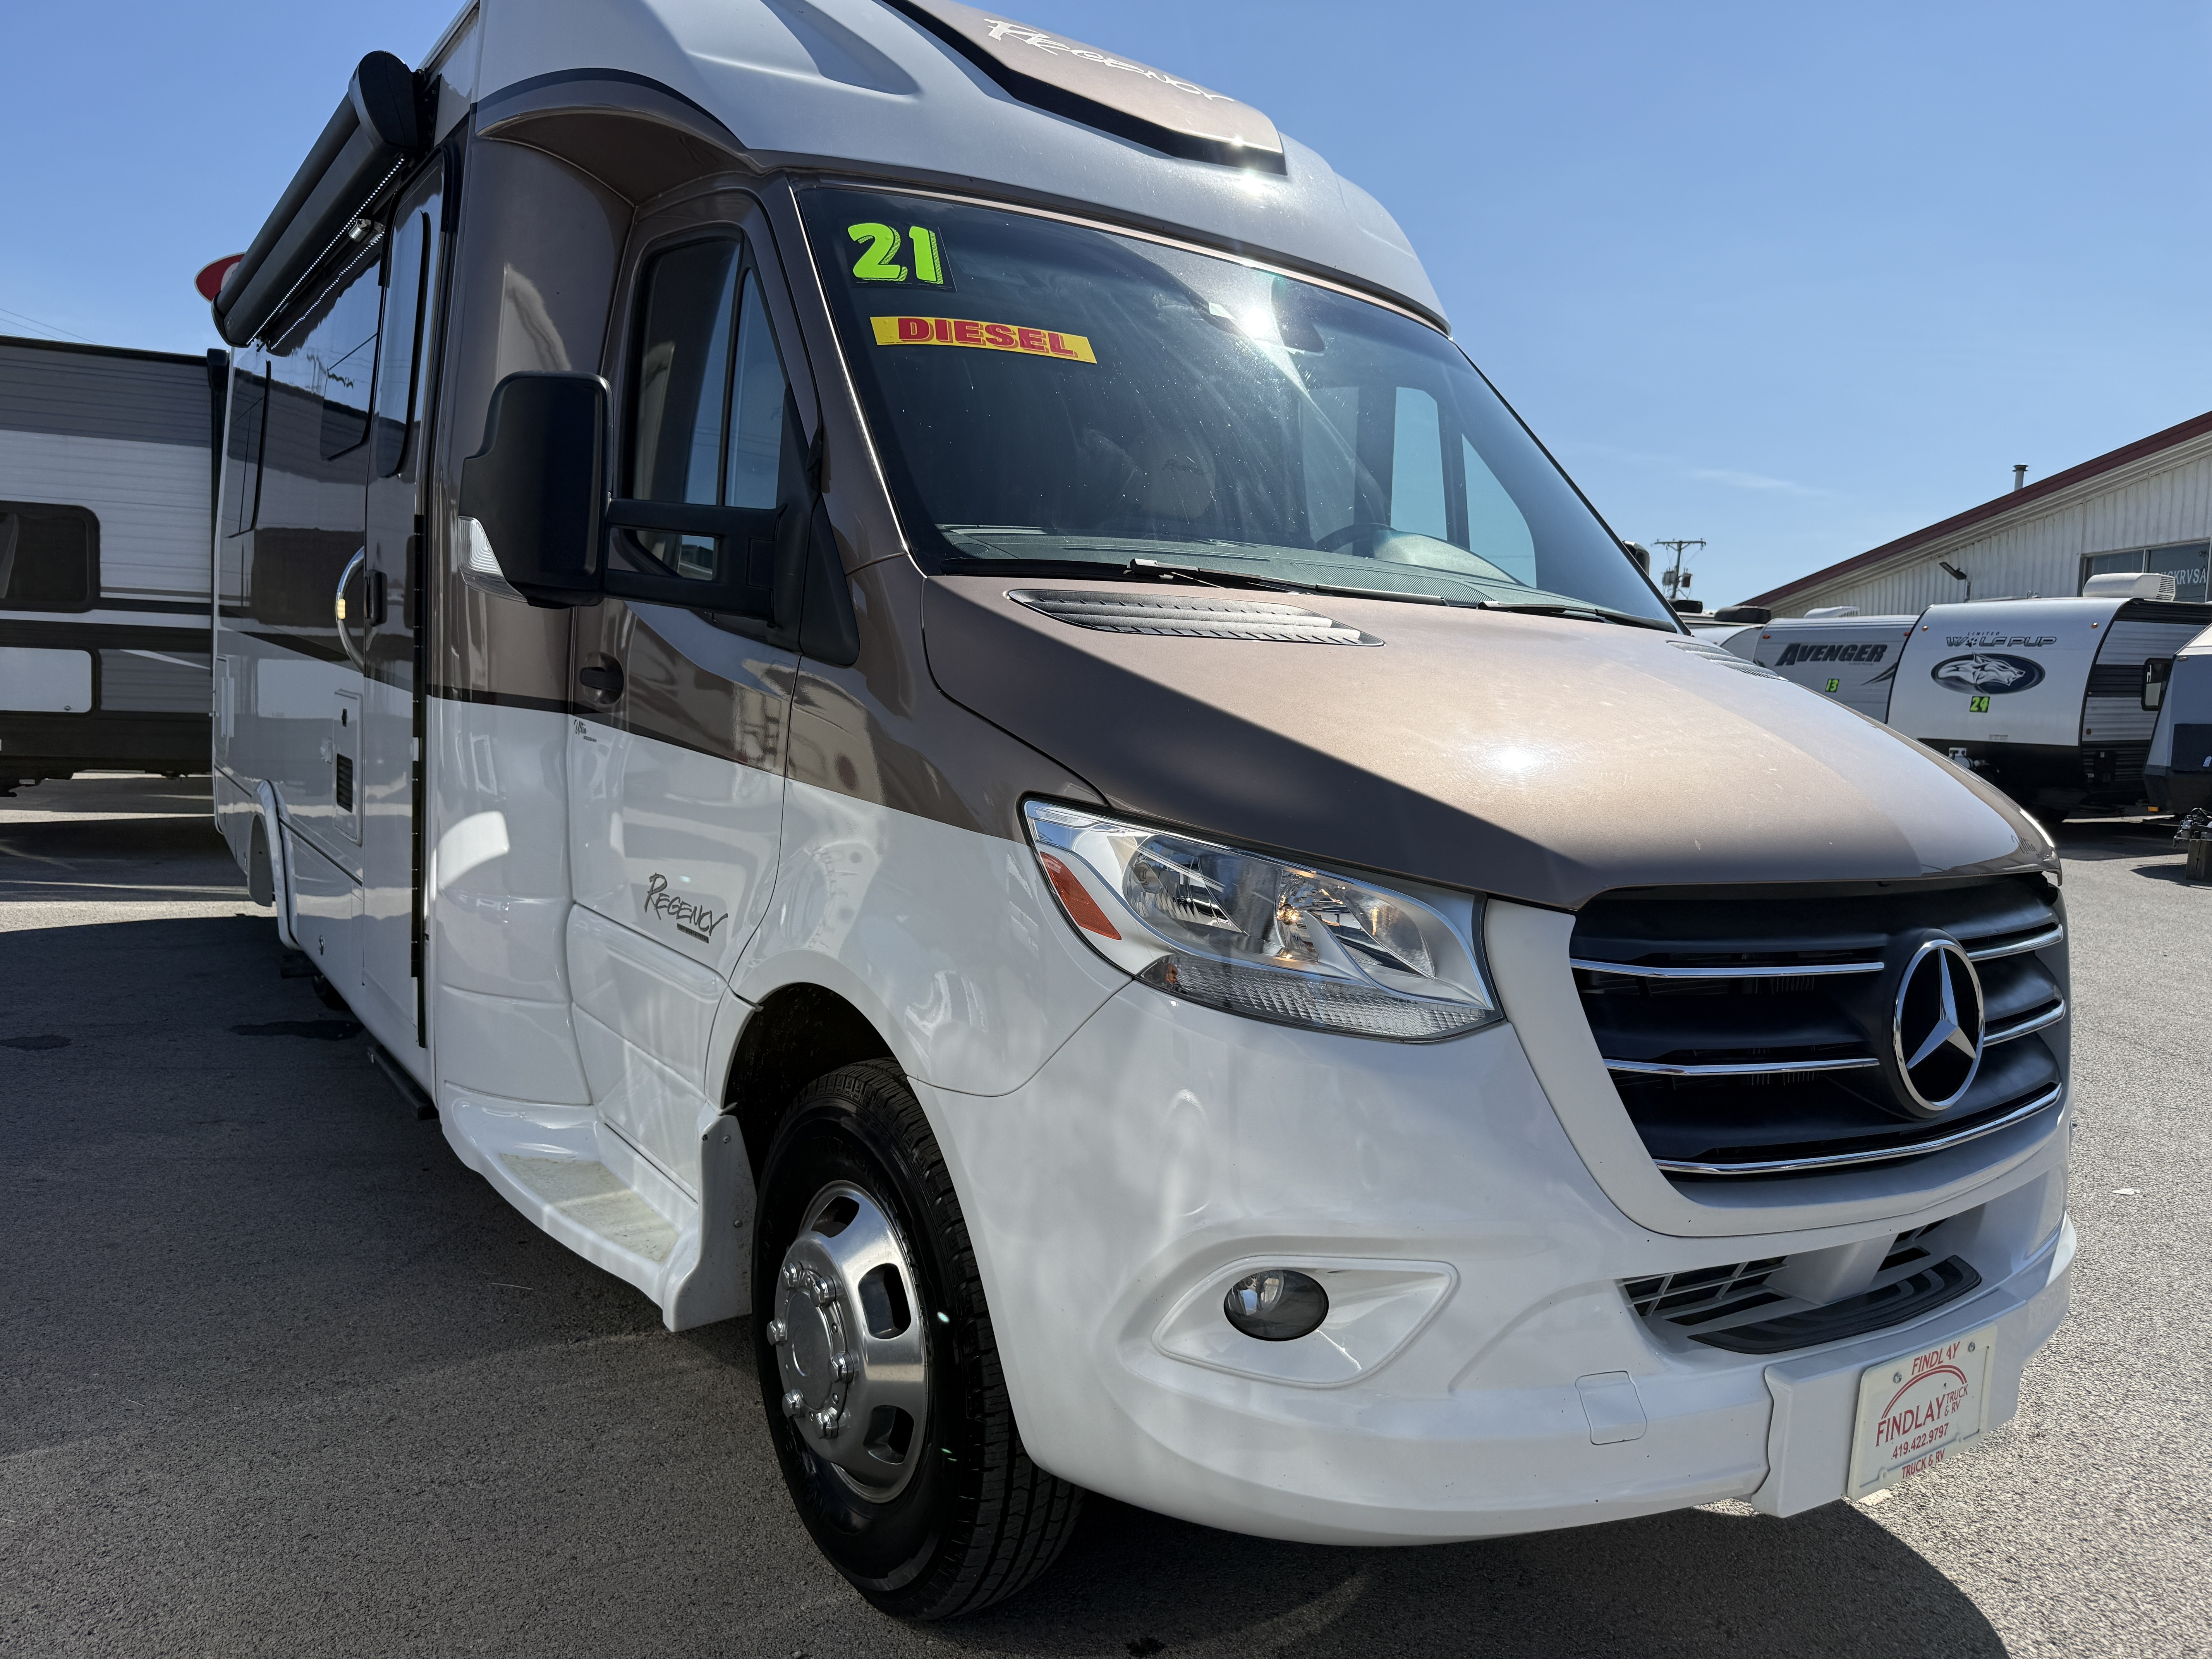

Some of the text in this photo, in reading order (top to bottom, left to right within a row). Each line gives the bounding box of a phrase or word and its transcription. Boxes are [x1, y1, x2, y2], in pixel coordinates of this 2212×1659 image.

[847, 223, 944, 285] 21
[898, 318, 1078, 358] DIESEL
[1774, 643, 1887, 666] AVENGER
[2007, 636, 2057, 647] PUP
[1826, 679, 1839, 692] 13
[1970, 697, 1989, 712] 24
[644, 872, 728, 936] REGENCY
[1911, 1341, 1960, 1376] FINDLAY
[1944, 1400, 1961, 1416] & RV
[1946, 1384, 1968, 1404] TRUCK
[1875, 1394, 1946, 1447] FINDLAY
[1893, 1422, 1949, 1459] 419.422.9797
[1902, 1448, 1945, 1479] TRUCK & RV
